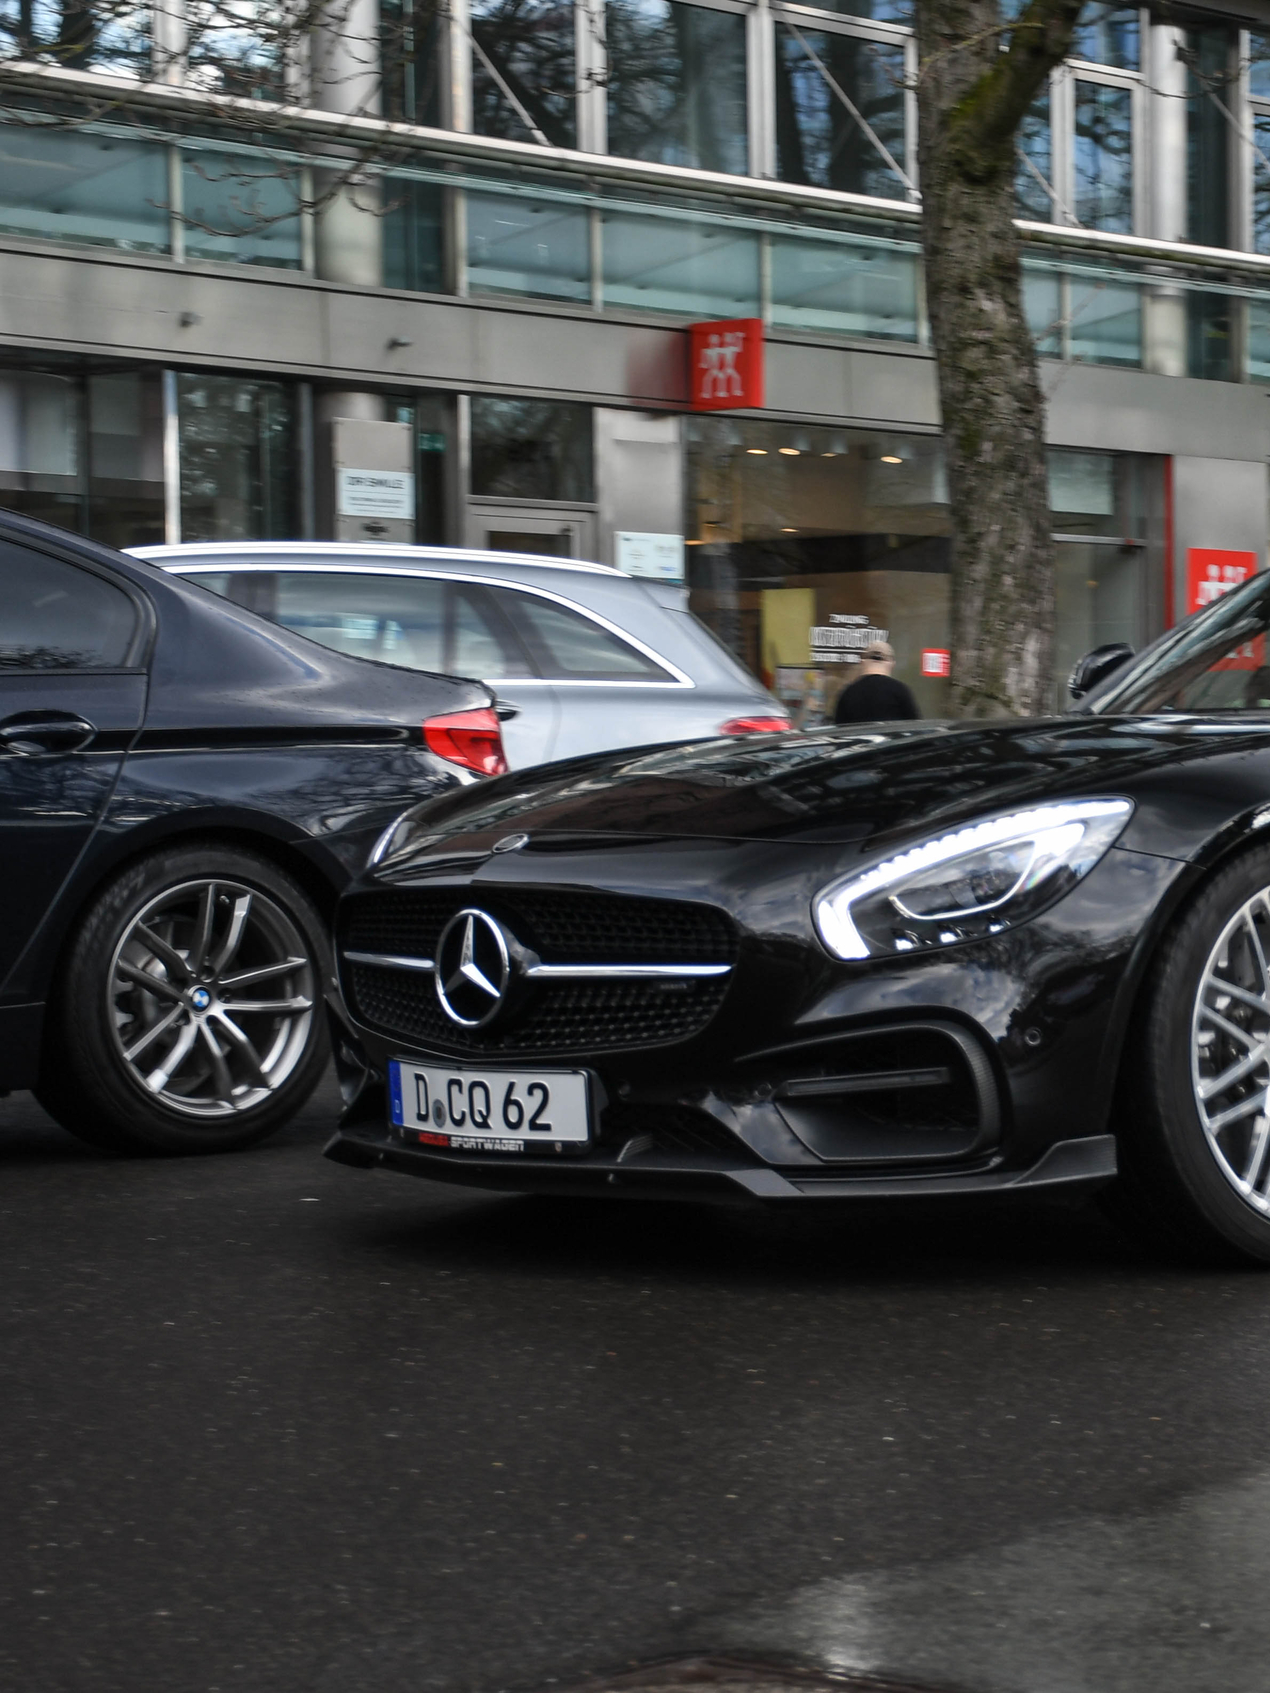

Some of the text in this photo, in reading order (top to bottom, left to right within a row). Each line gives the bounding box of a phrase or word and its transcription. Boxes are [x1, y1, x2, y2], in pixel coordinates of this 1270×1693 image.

[414, 1072, 552, 1132] D CQ 62
[450, 1136, 525, 1152] SPORTWAGEN
